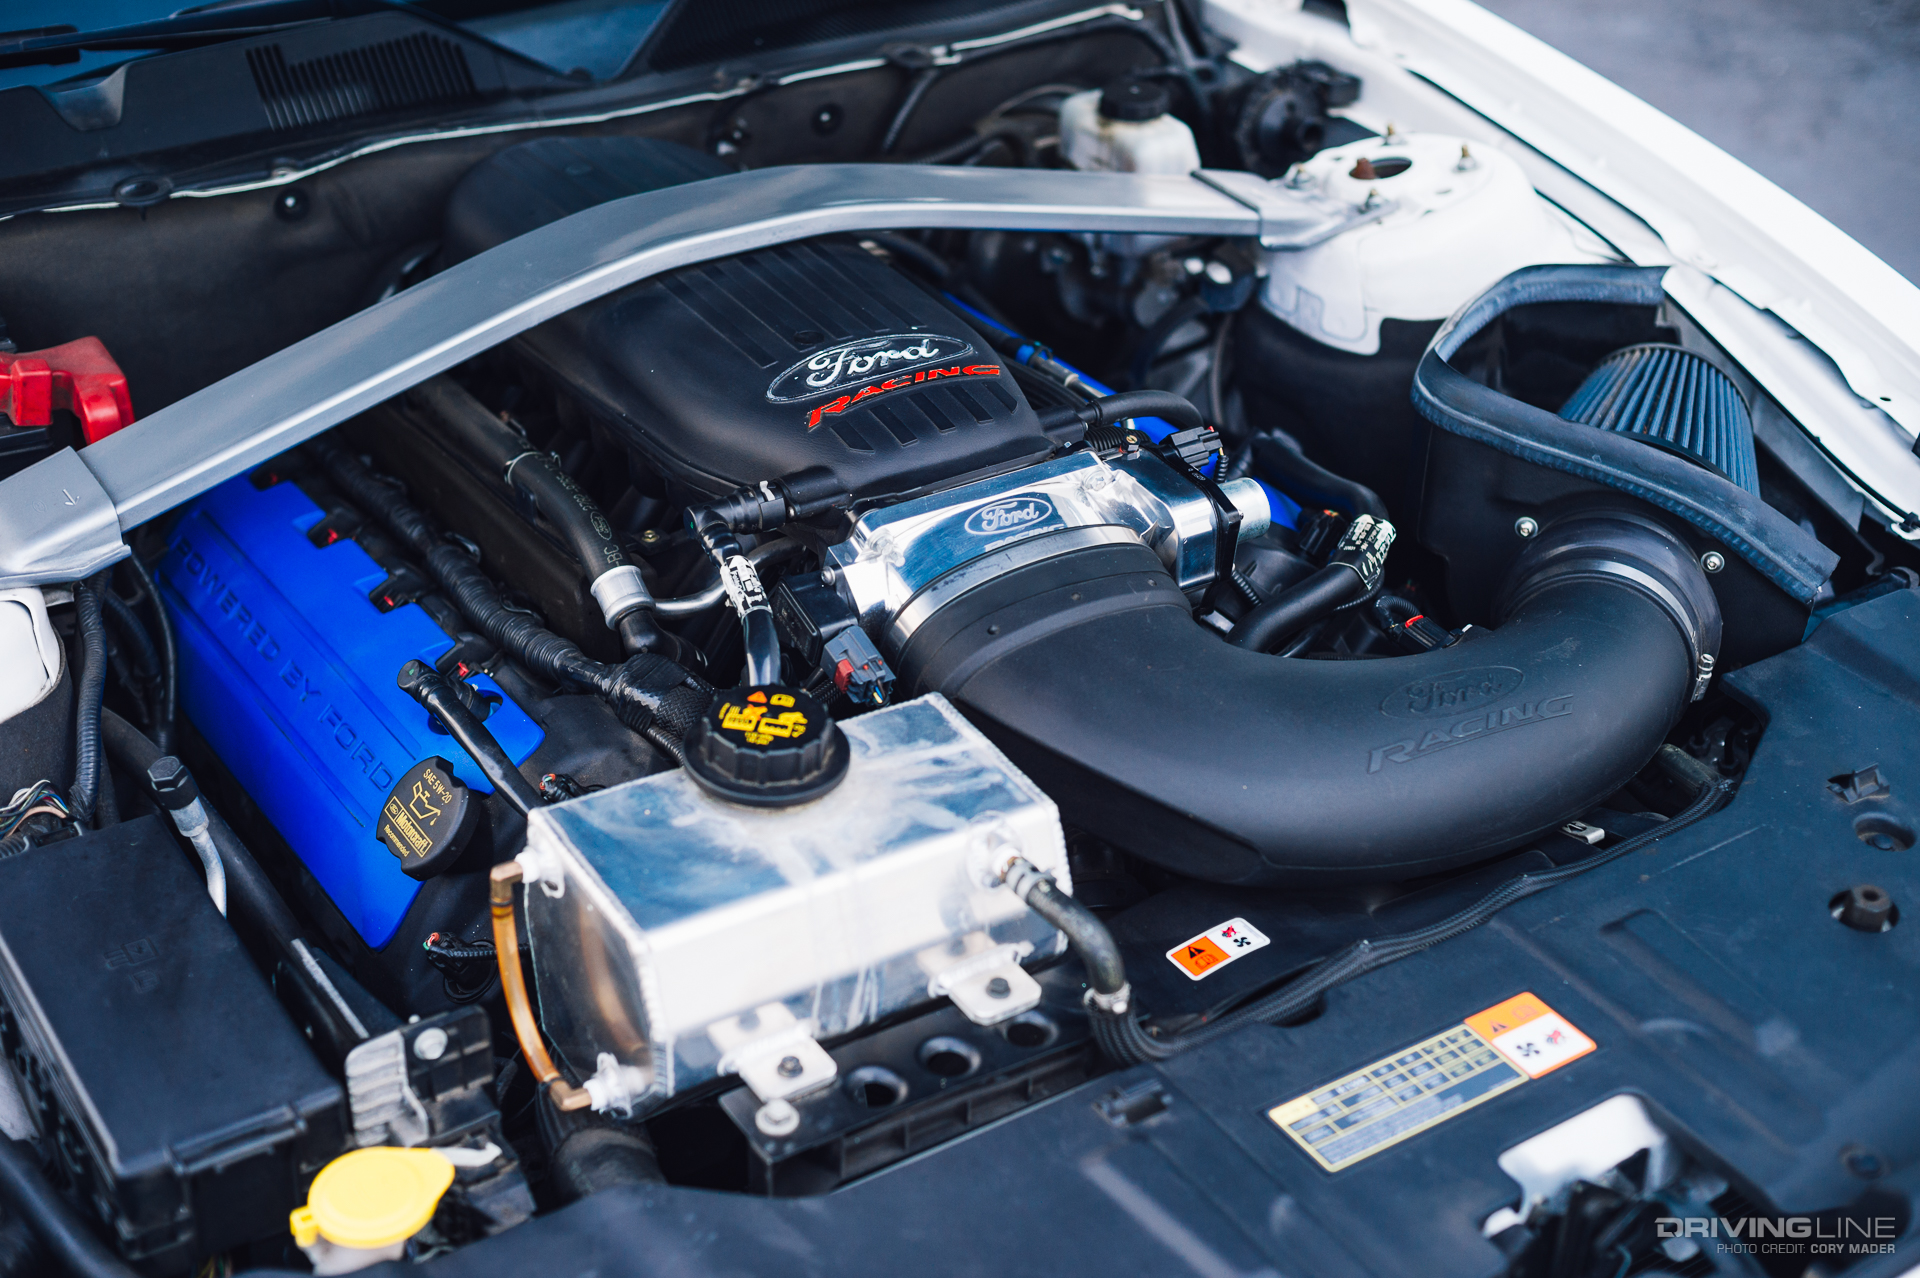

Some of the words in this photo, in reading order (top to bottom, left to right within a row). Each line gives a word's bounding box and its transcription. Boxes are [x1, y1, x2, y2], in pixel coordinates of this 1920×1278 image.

[806, 339, 940, 388] Ford
[807, 364, 1001, 429] RACING
[981, 501, 1040, 532] Ford
[168, 534, 282, 663] POWERED
[278, 658, 322, 703] BY
[317, 703, 396, 792] FORD
[1406, 673, 1503, 714] Ford
[1367, 693, 1574, 775] RACING
[423, 769, 437, 786] SAE
[432, 780, 453, 804] 5W-20
[383, 824, 410, 857] Recommended
[396, 811, 429, 853] Motorcraft
